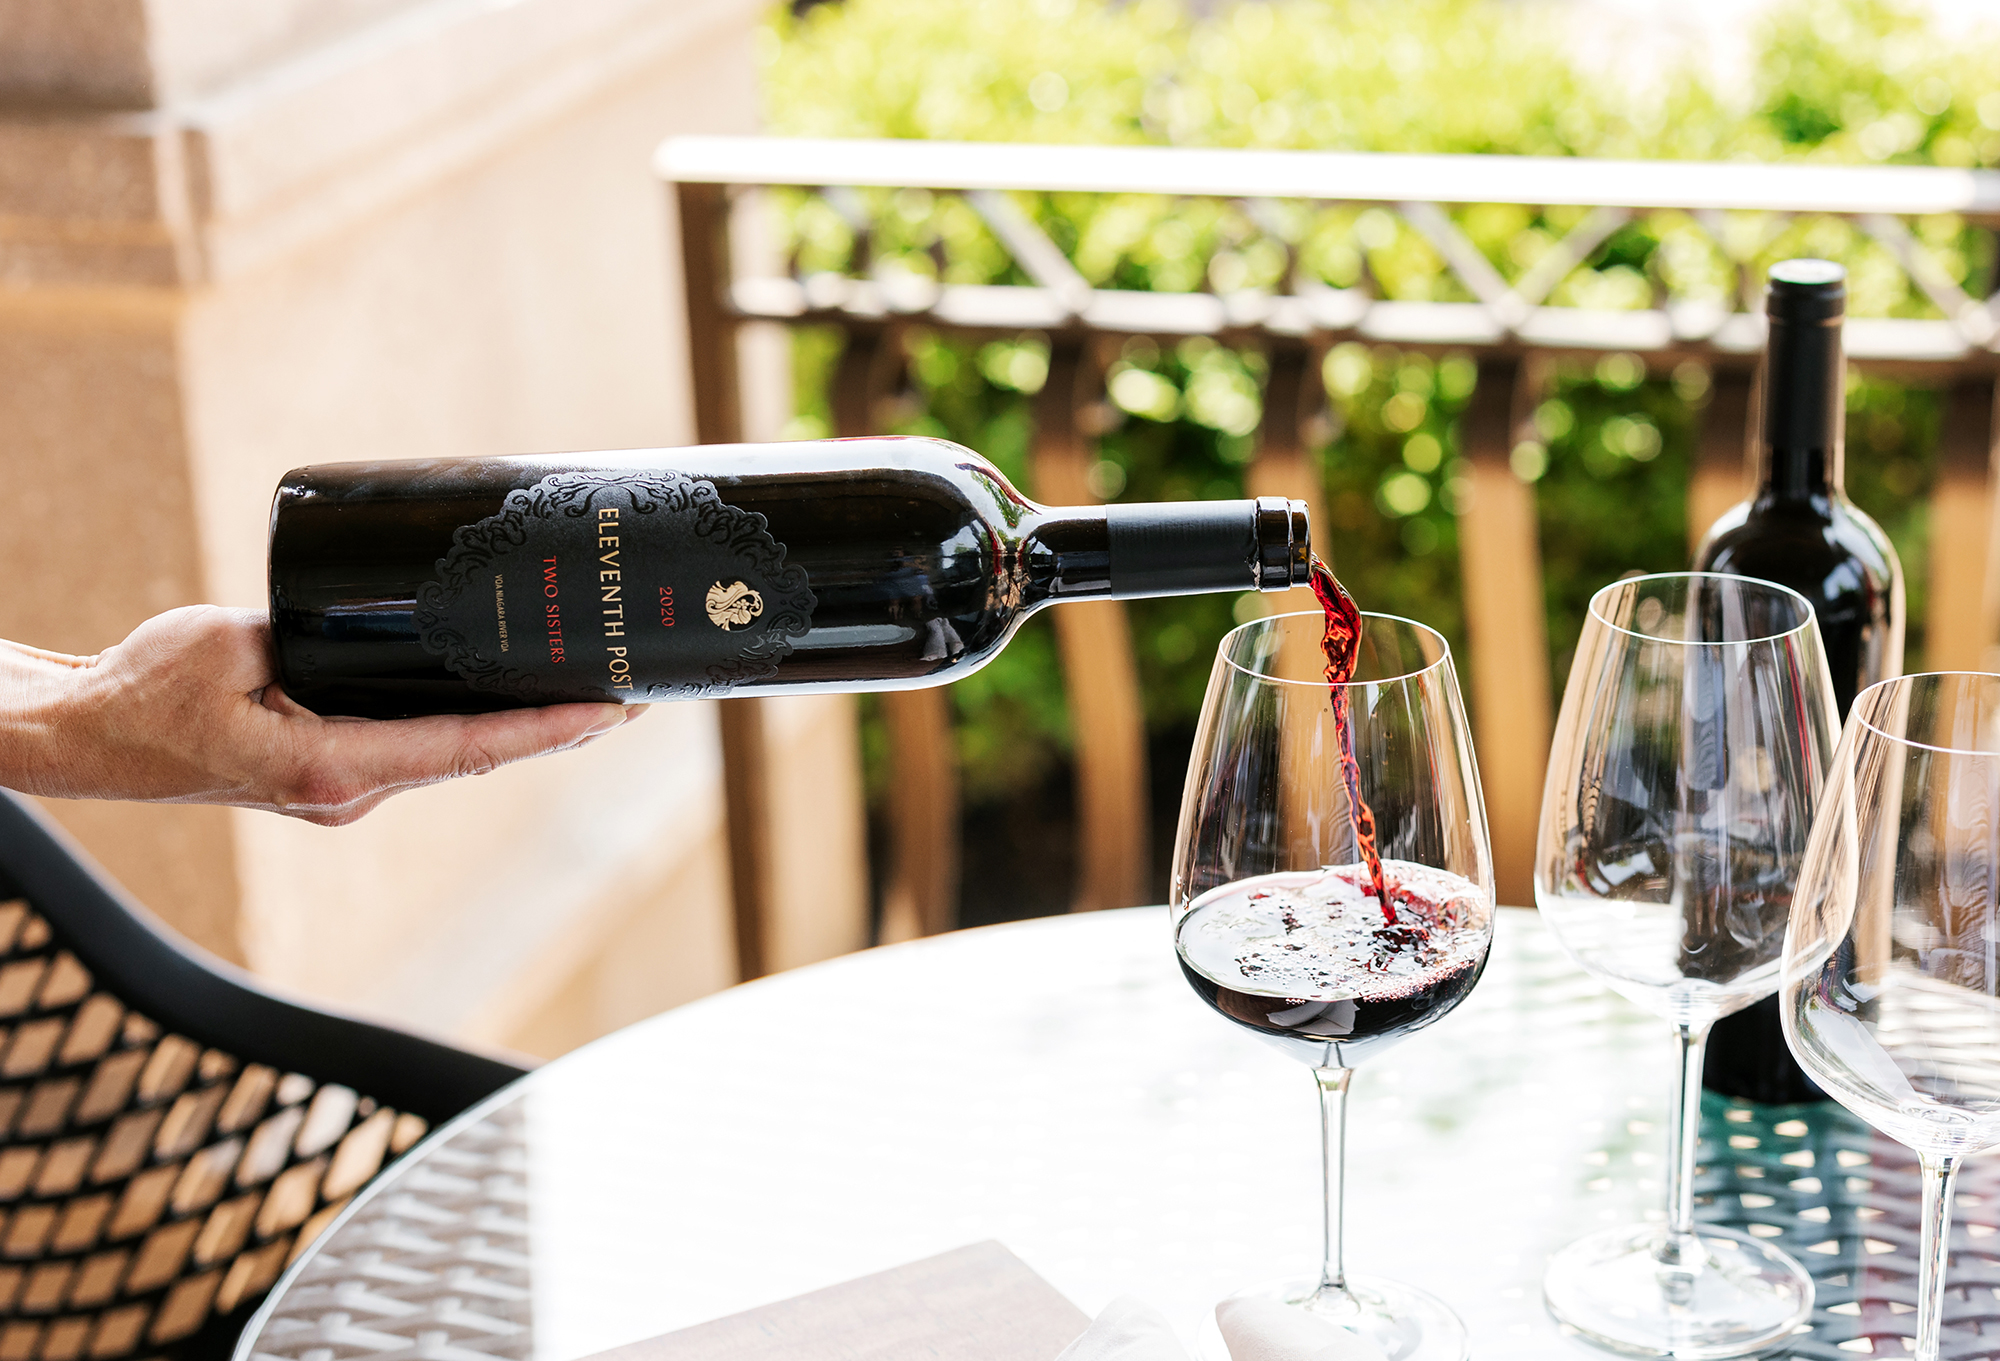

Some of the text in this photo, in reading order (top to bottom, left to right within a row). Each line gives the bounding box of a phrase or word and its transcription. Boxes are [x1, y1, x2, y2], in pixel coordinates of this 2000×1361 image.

[494, 574, 509, 653] VQA NIAGARA RIVER VQA
[543, 555, 565, 664] TWO SISTERS
[598, 508, 633, 691] ELEVENTH POST
[659, 586, 675, 627] 2020
